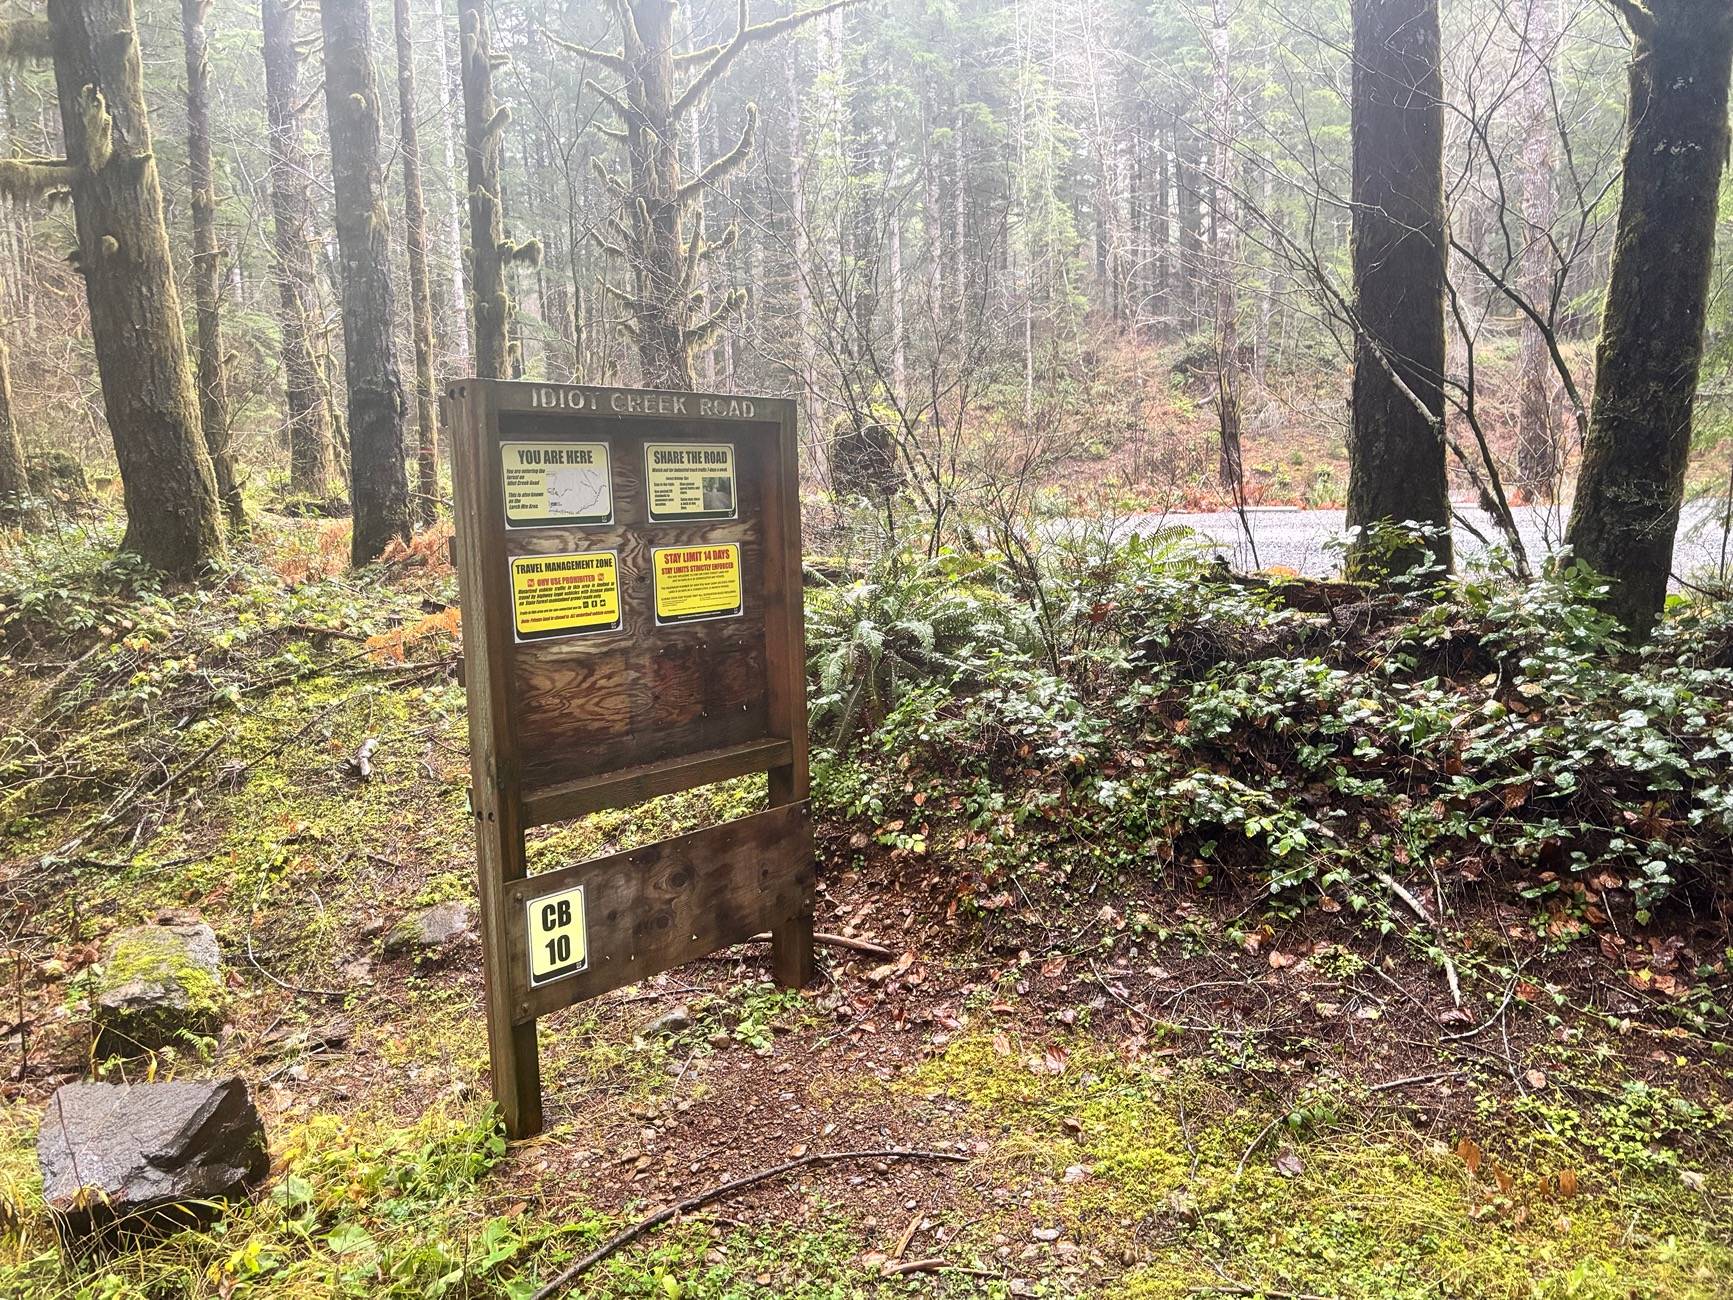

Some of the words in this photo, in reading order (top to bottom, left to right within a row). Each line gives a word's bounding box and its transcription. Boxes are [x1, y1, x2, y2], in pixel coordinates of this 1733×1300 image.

[531, 388, 599, 409] IDIOT
[610, 392, 687, 414] CREEK
[700, 398, 755, 418] ROAD
[517, 450, 541, 465] YOU
[543, 450, 564, 464] ARE
[566, 450, 593, 464] HERE
[654, 450, 684, 464] SHARE
[685, 451, 703, 464] THE
[704, 450, 727, 464] ROAD
[664, 552, 682, 564] STAY
[683, 551, 702, 562] LIMIT
[704, 551, 712, 561] 14
[712, 549, 730, 560] DAYS
[515, 563, 543, 574] TRAVEL
[545, 559, 594, 572] MANAGEMENT
[596, 558, 613, 568] ZONE
[674, 566, 689, 574] LIMITS
[690, 564, 711, 572] STRICTLY
[712, 562, 733, 570] ENFORCED
[550, 576, 562, 585] USE
[562, 574, 595, 585] PROHIBITED
[542, 900, 572, 932] CB
[545, 934, 570, 965] 10
